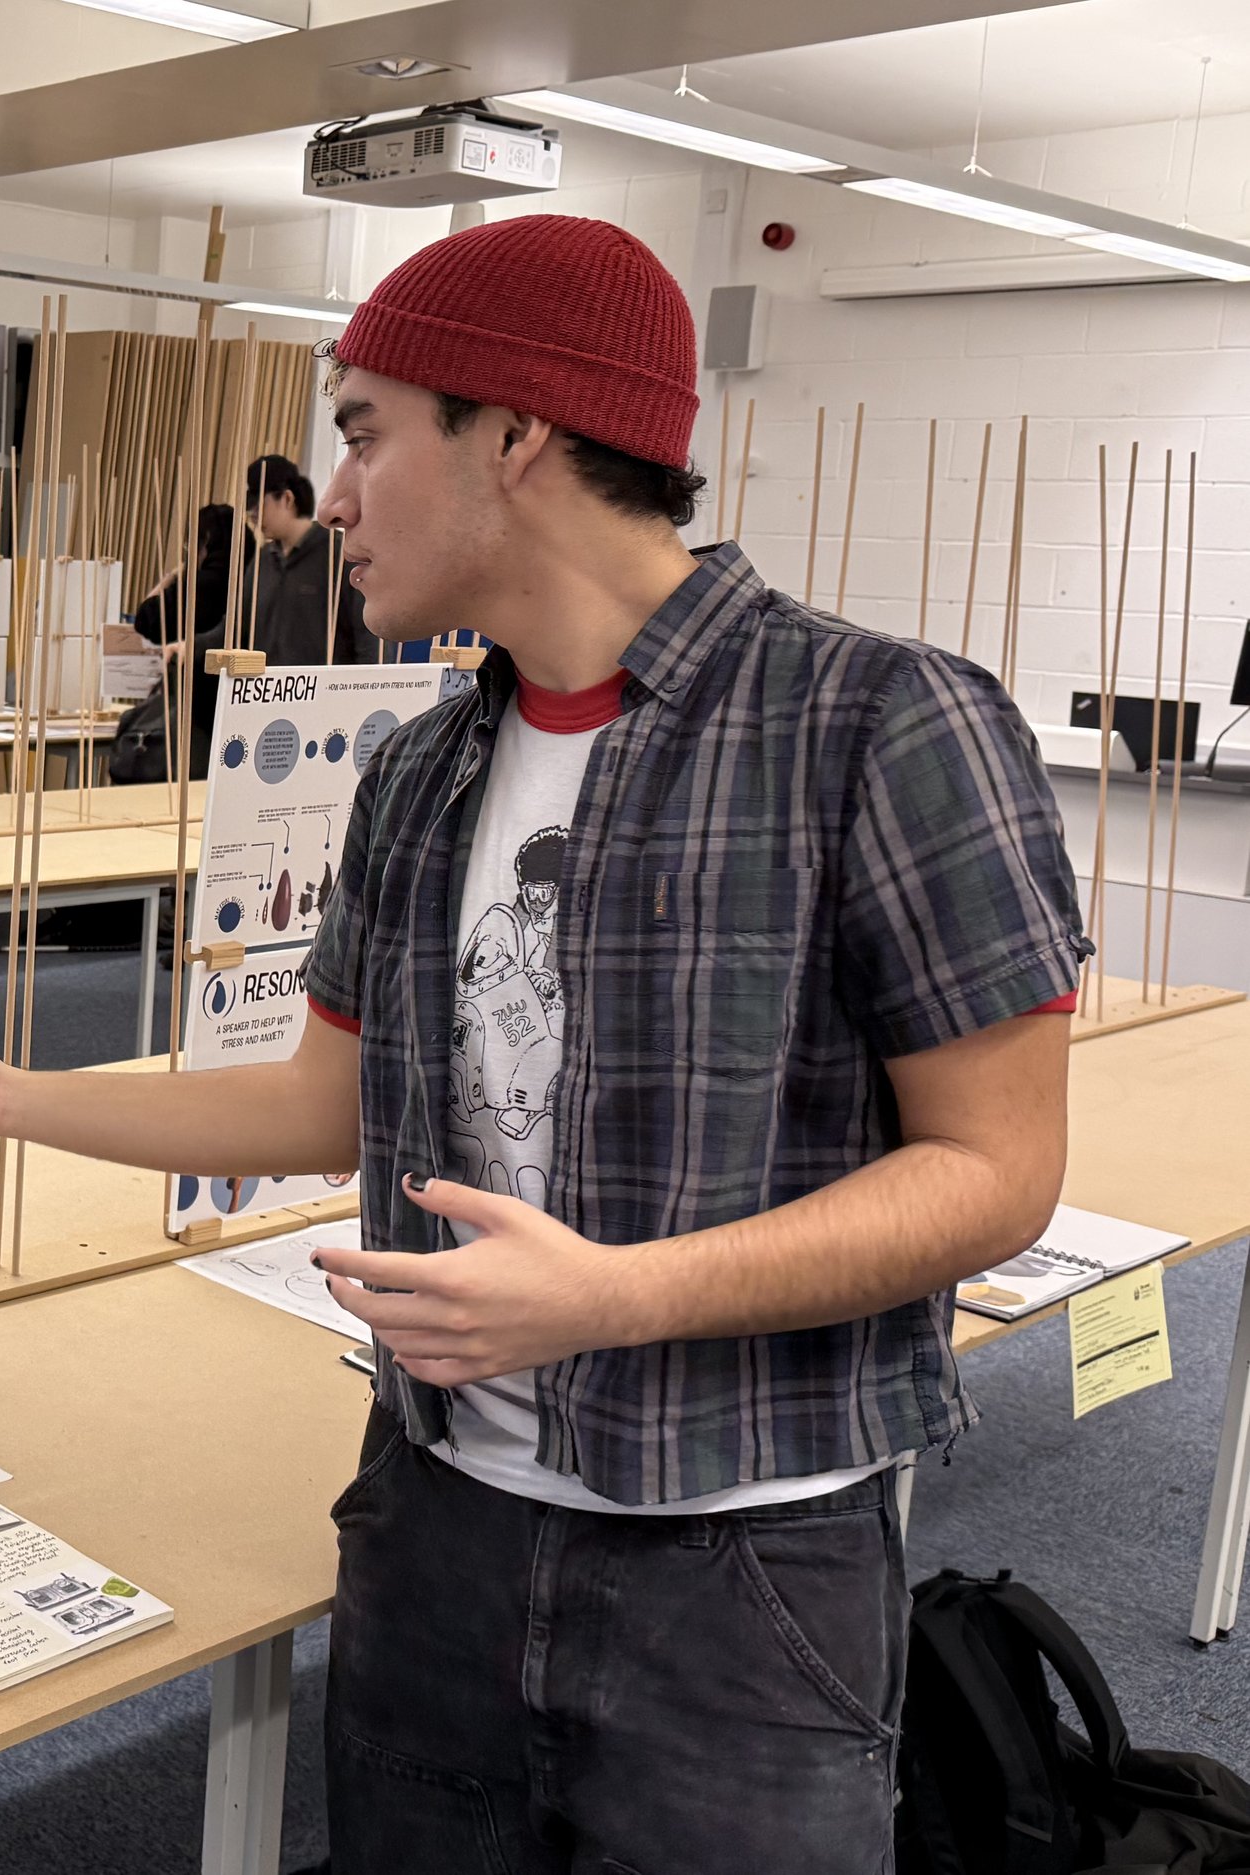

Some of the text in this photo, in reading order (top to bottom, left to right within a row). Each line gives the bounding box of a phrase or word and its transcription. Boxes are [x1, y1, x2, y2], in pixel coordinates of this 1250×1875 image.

[230, 675, 317, 705] RESEARCH
[216, 1014, 293, 1035] A SPEAKER TO HELP WITH
[492, 999, 527, 1026] ZULU
[222, 1030, 285, 1049] STRESS AND ANXIETY
[502, 1016, 536, 1047] 52
